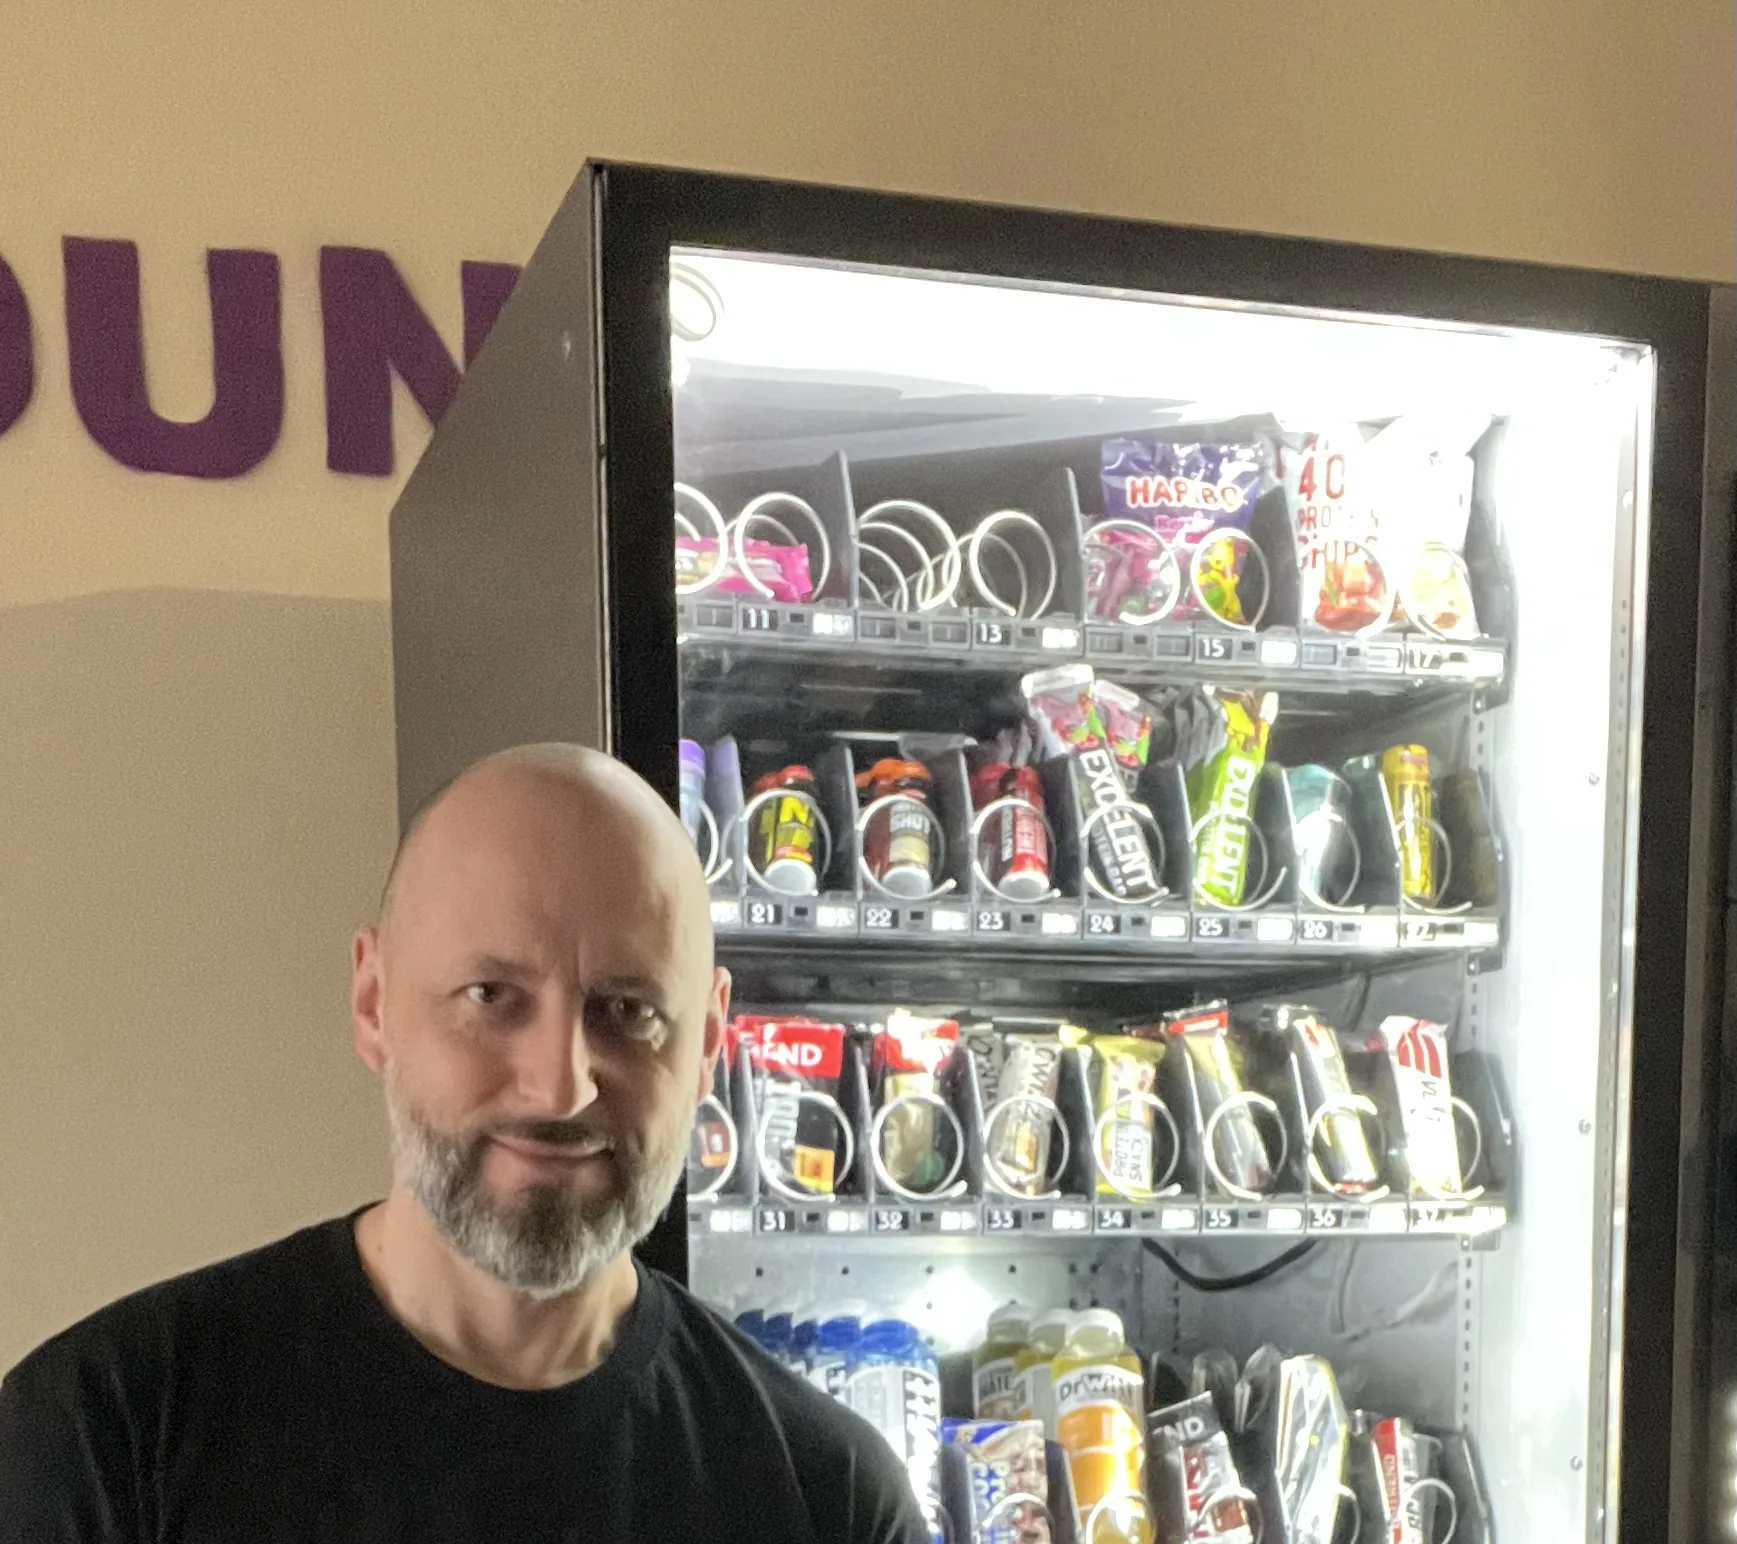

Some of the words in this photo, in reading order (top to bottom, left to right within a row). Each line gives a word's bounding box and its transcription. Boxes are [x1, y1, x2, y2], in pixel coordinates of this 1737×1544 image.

[0, 233, 522, 480] UN
[747, 609, 769, 629] 11
[979, 624, 1002, 643] 13
[1202, 639, 1225, 658] 15
[751, 905, 775, 924] 21
[866, 909, 891, 928] 22
[979, 912, 1004, 931] 23
[1090, 916, 1115, 933] 24
[763, 1210, 786, 1230] 31
[988, 1211, 1014, 1229] 33
[1100, 1210, 1125, 1228] 34
[1208, 1210, 1232, 1228] 35
[1312, 1208, 1336, 1227] 36
